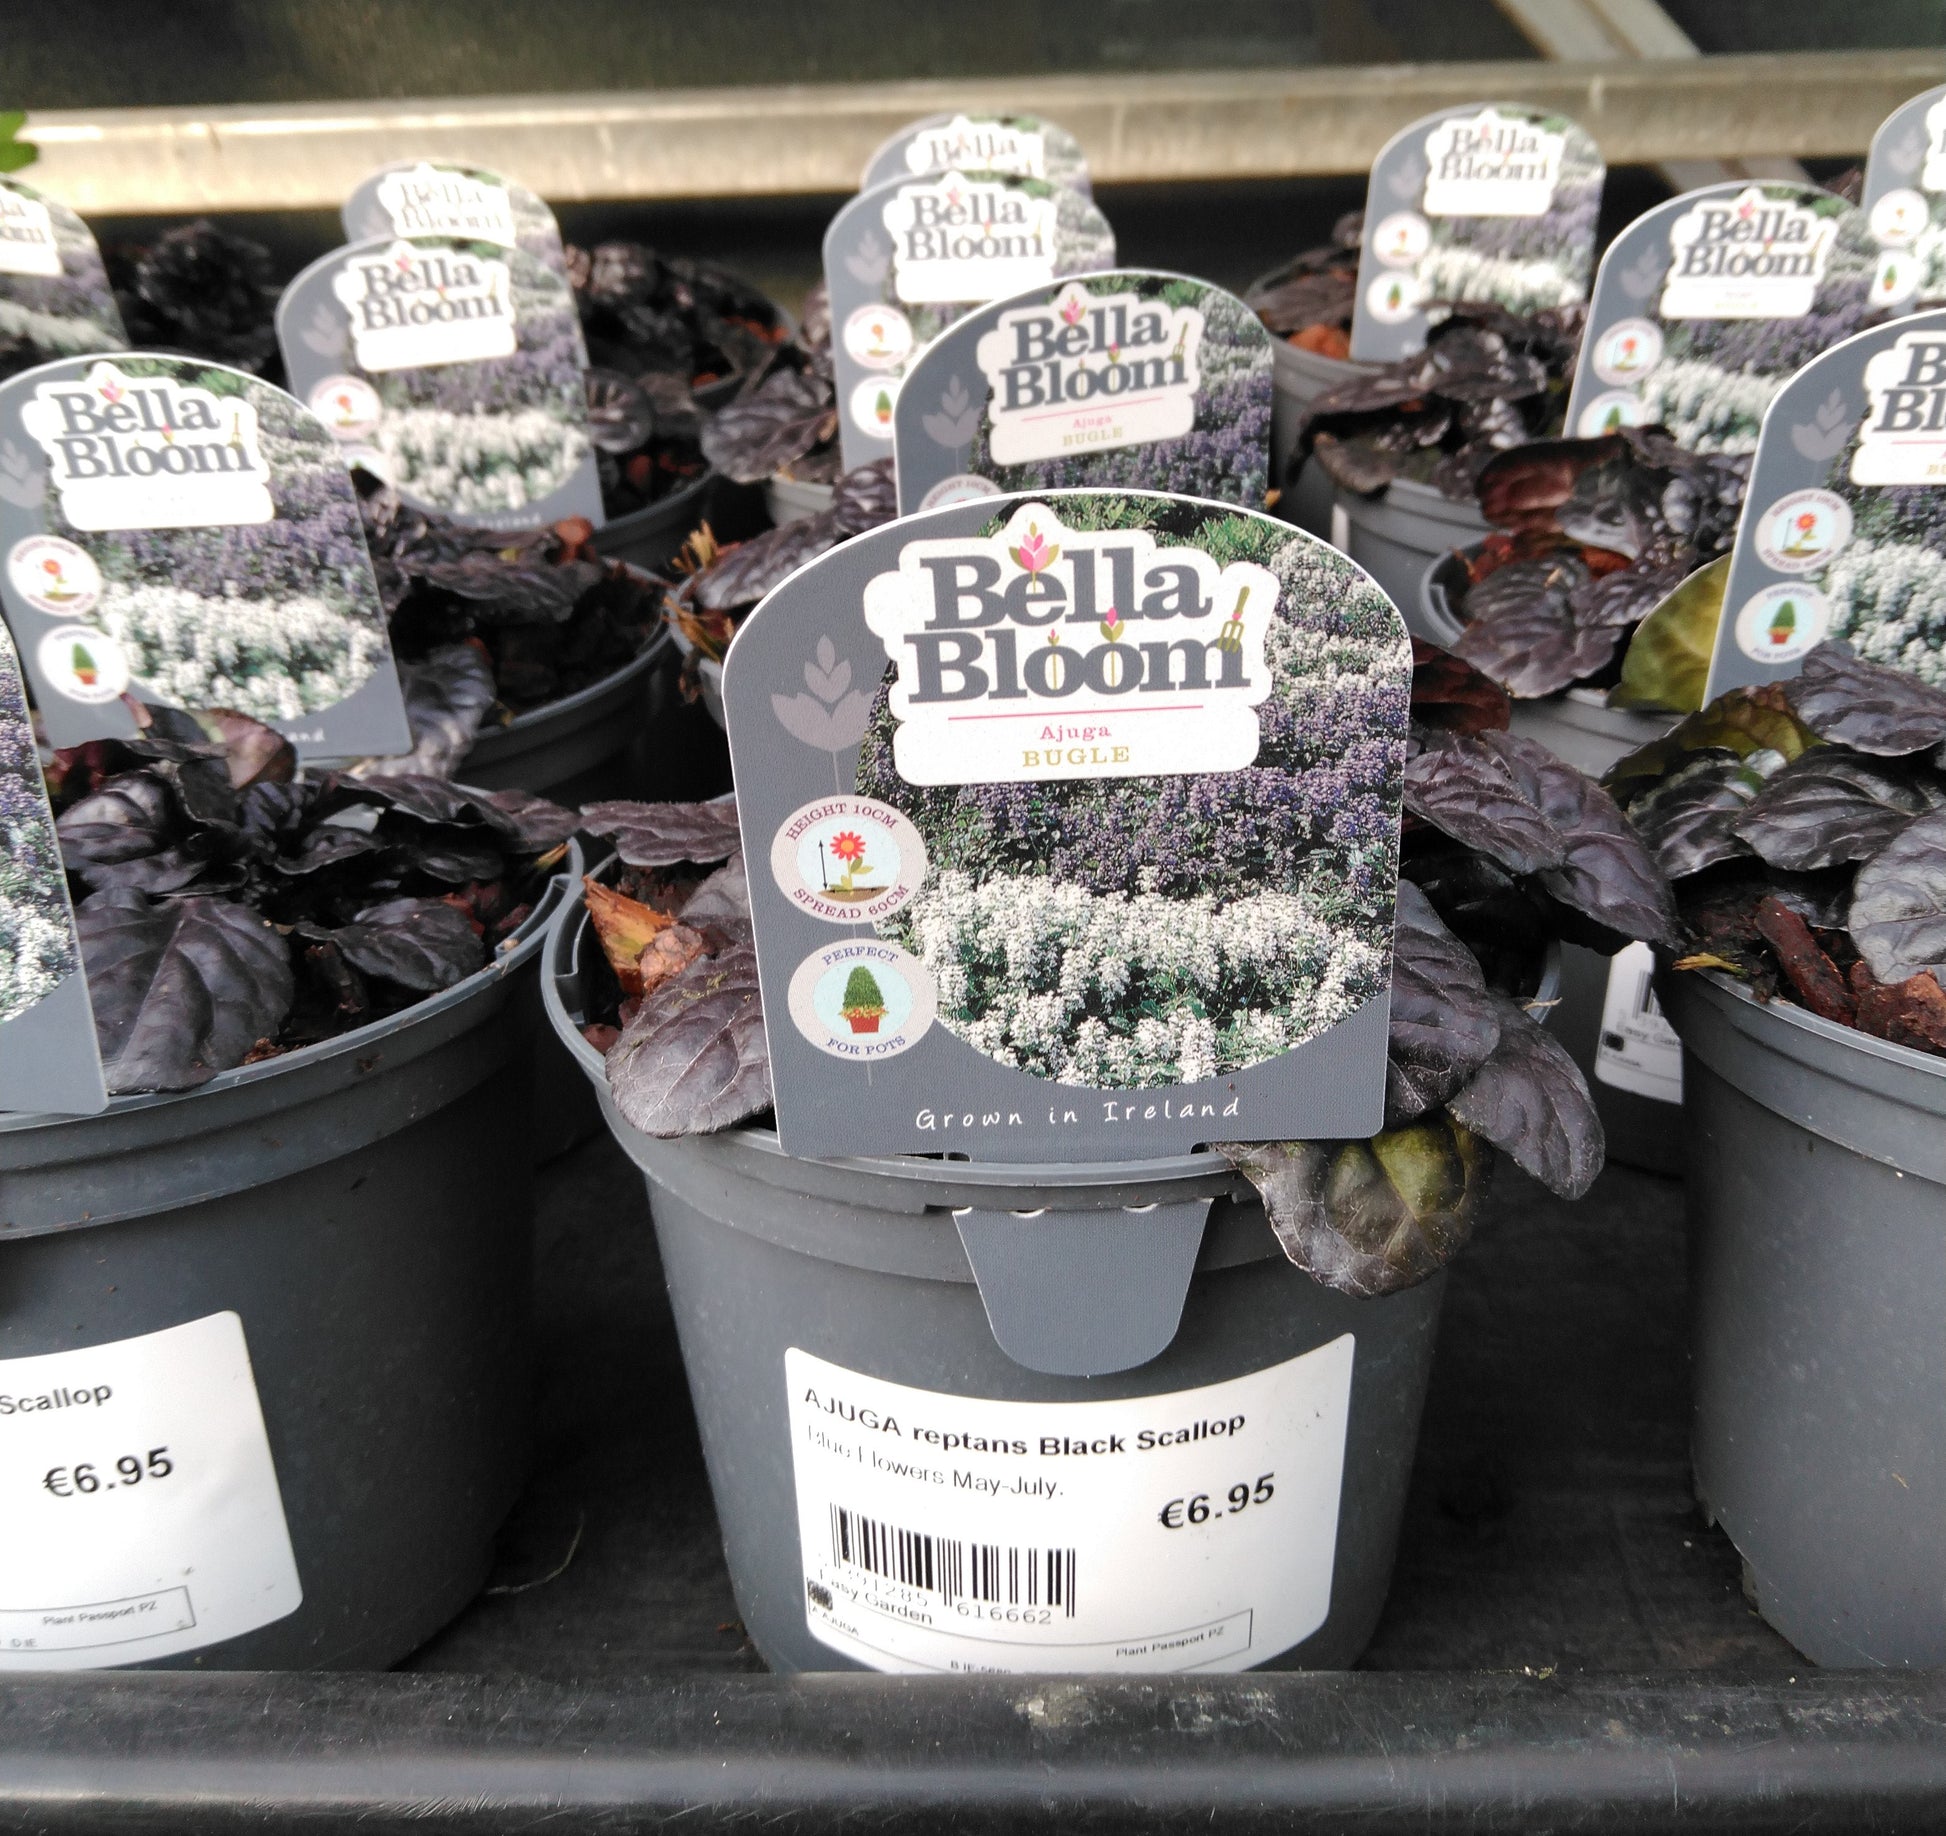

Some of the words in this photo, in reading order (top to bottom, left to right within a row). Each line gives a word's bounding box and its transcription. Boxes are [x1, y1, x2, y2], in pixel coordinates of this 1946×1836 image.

[1449, 128, 1539, 155] Bella
[1438, 153, 1549, 181] Bloom
[911, 192, 1028, 228] Bella
[1700, 208, 1810, 244] Bella
[904, 224, 1045, 262] Bloom
[1677, 243, 1816, 278] Bloom
[359, 257, 482, 296] Bella
[357, 295, 504, 331] Bloom
[1009, 304, 1168, 366] Bella
[999, 350, 1189, 413] Bloom
[49, 388, 221, 437] Bella
[1072, 413, 1113, 430] Ajuga
[1062, 426, 1123, 448] BUGLE
[52, 435, 257, 480] Bloom
[920, 546, 1214, 631] Bella
[904, 627, 1252, 705] Bloom
[1039, 721, 1113, 743] Ajuga
[1021, 745, 1132, 769] BUGLE
[785, 802, 847, 842] HEIGHT
[852, 803, 900, 829] 10CM
[793, 887, 862, 920] SPREAD
[867, 883, 911, 917] 60CM
[821, 946, 899, 966] PERFECT
[826, 1037, 861, 1056] FOR
[866, 1035, 907, 1056] POTS
[915, 1107, 1023, 1131] Grown
[1048, 1105, 1079, 1125] in
[1103, 1097, 1241, 1122] Ireland
[0, 1384, 114, 1416] Scallop
[805, 1387, 902, 1437] AJUGA
[912, 1426, 1029, 1456] reptans
[1038, 1433, 1127, 1458] Black
[1136, 1411, 1246, 1452] Scallop
[41, 1445, 176, 1498] €6.95
[953, 1468, 1064, 1500] May-July.
[1157, 1470, 1276, 1531] €6.95
[846, 1569, 929, 1608] 1285
[956, 1602, 1052, 1626] 616662
[865, 1592, 933, 1626] Garden
[1116, 1645, 1148, 1658] Plant
[1151, 1631, 1205, 1653] Passport
[1207, 1625, 1225, 1639] PZ
